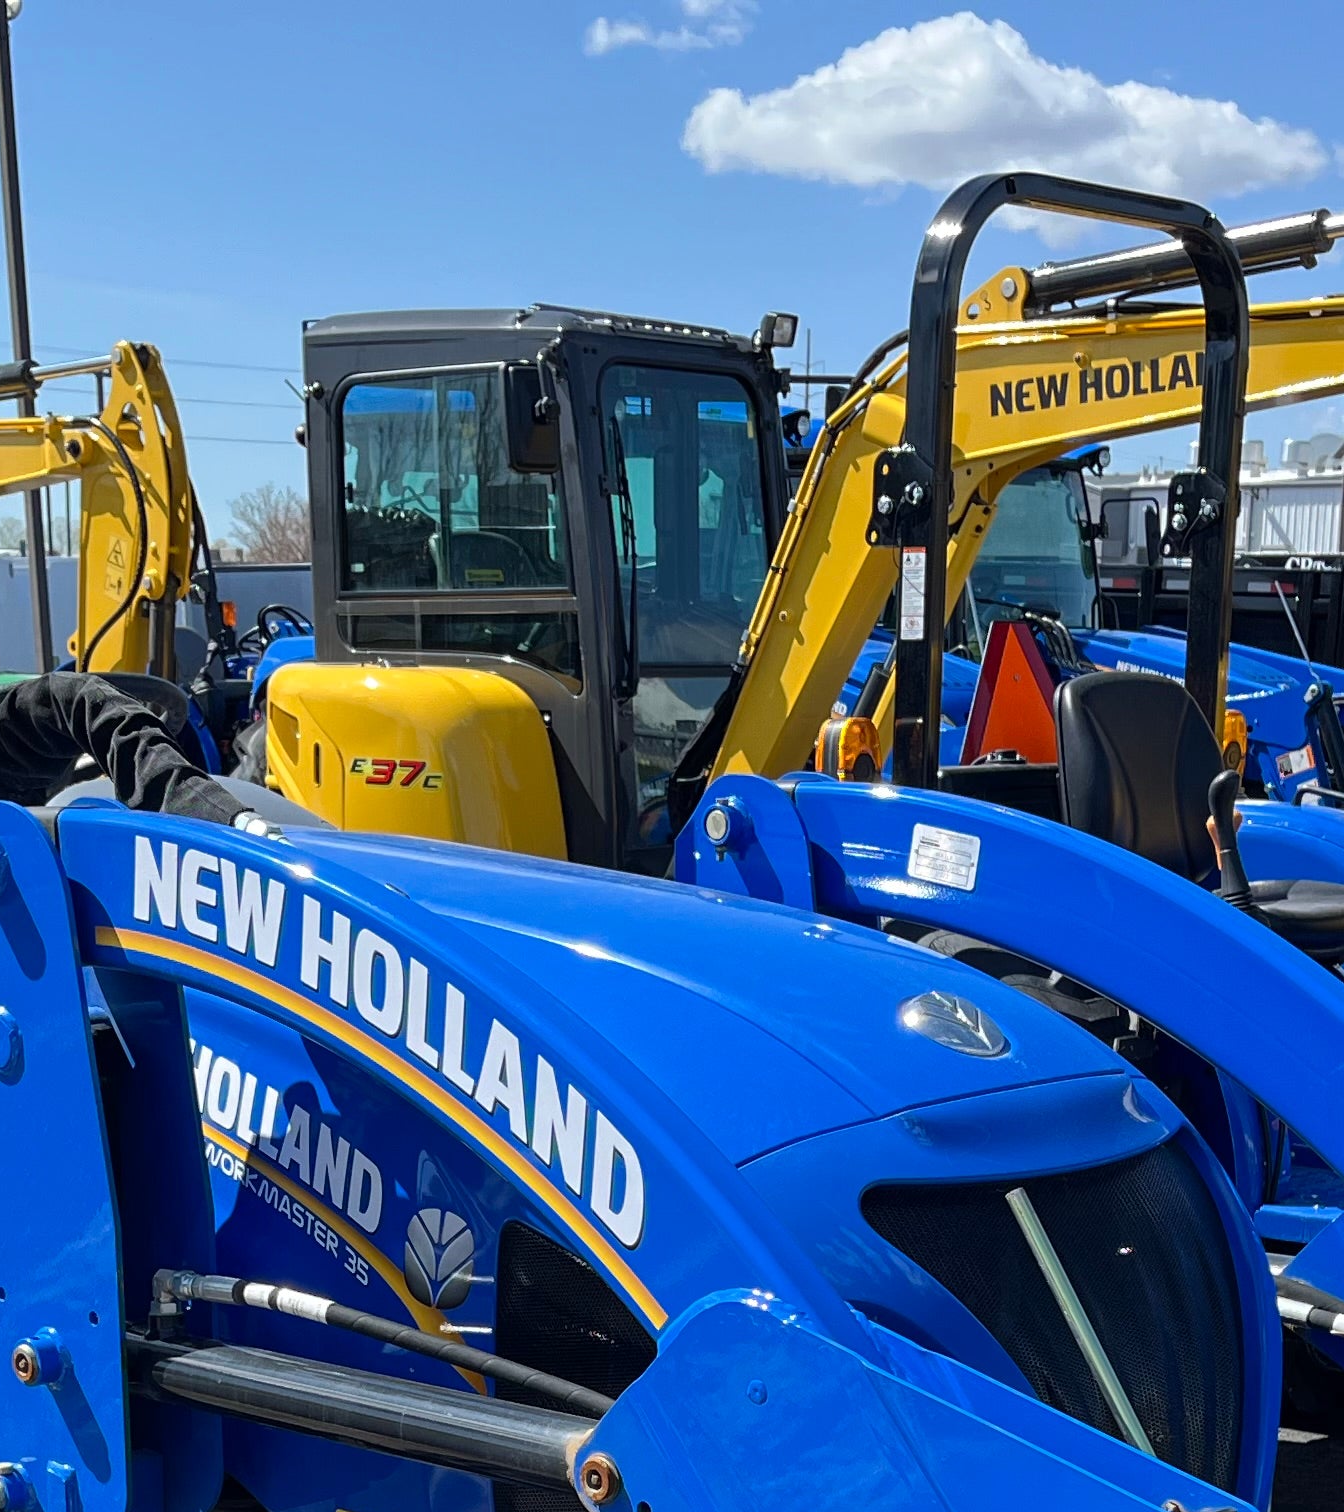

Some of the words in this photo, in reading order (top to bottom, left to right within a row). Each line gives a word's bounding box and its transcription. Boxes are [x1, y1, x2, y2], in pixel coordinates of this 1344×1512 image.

[990, 372, 1069, 417] NEW
[1079, 351, 1204, 404] HOLLA
[133, 835, 286, 968] NEW
[300, 894, 646, 1251] HOLLAND
[206, 1142, 339, 1259] WORKMASTER
[343, 1246, 370, 1287] 35
